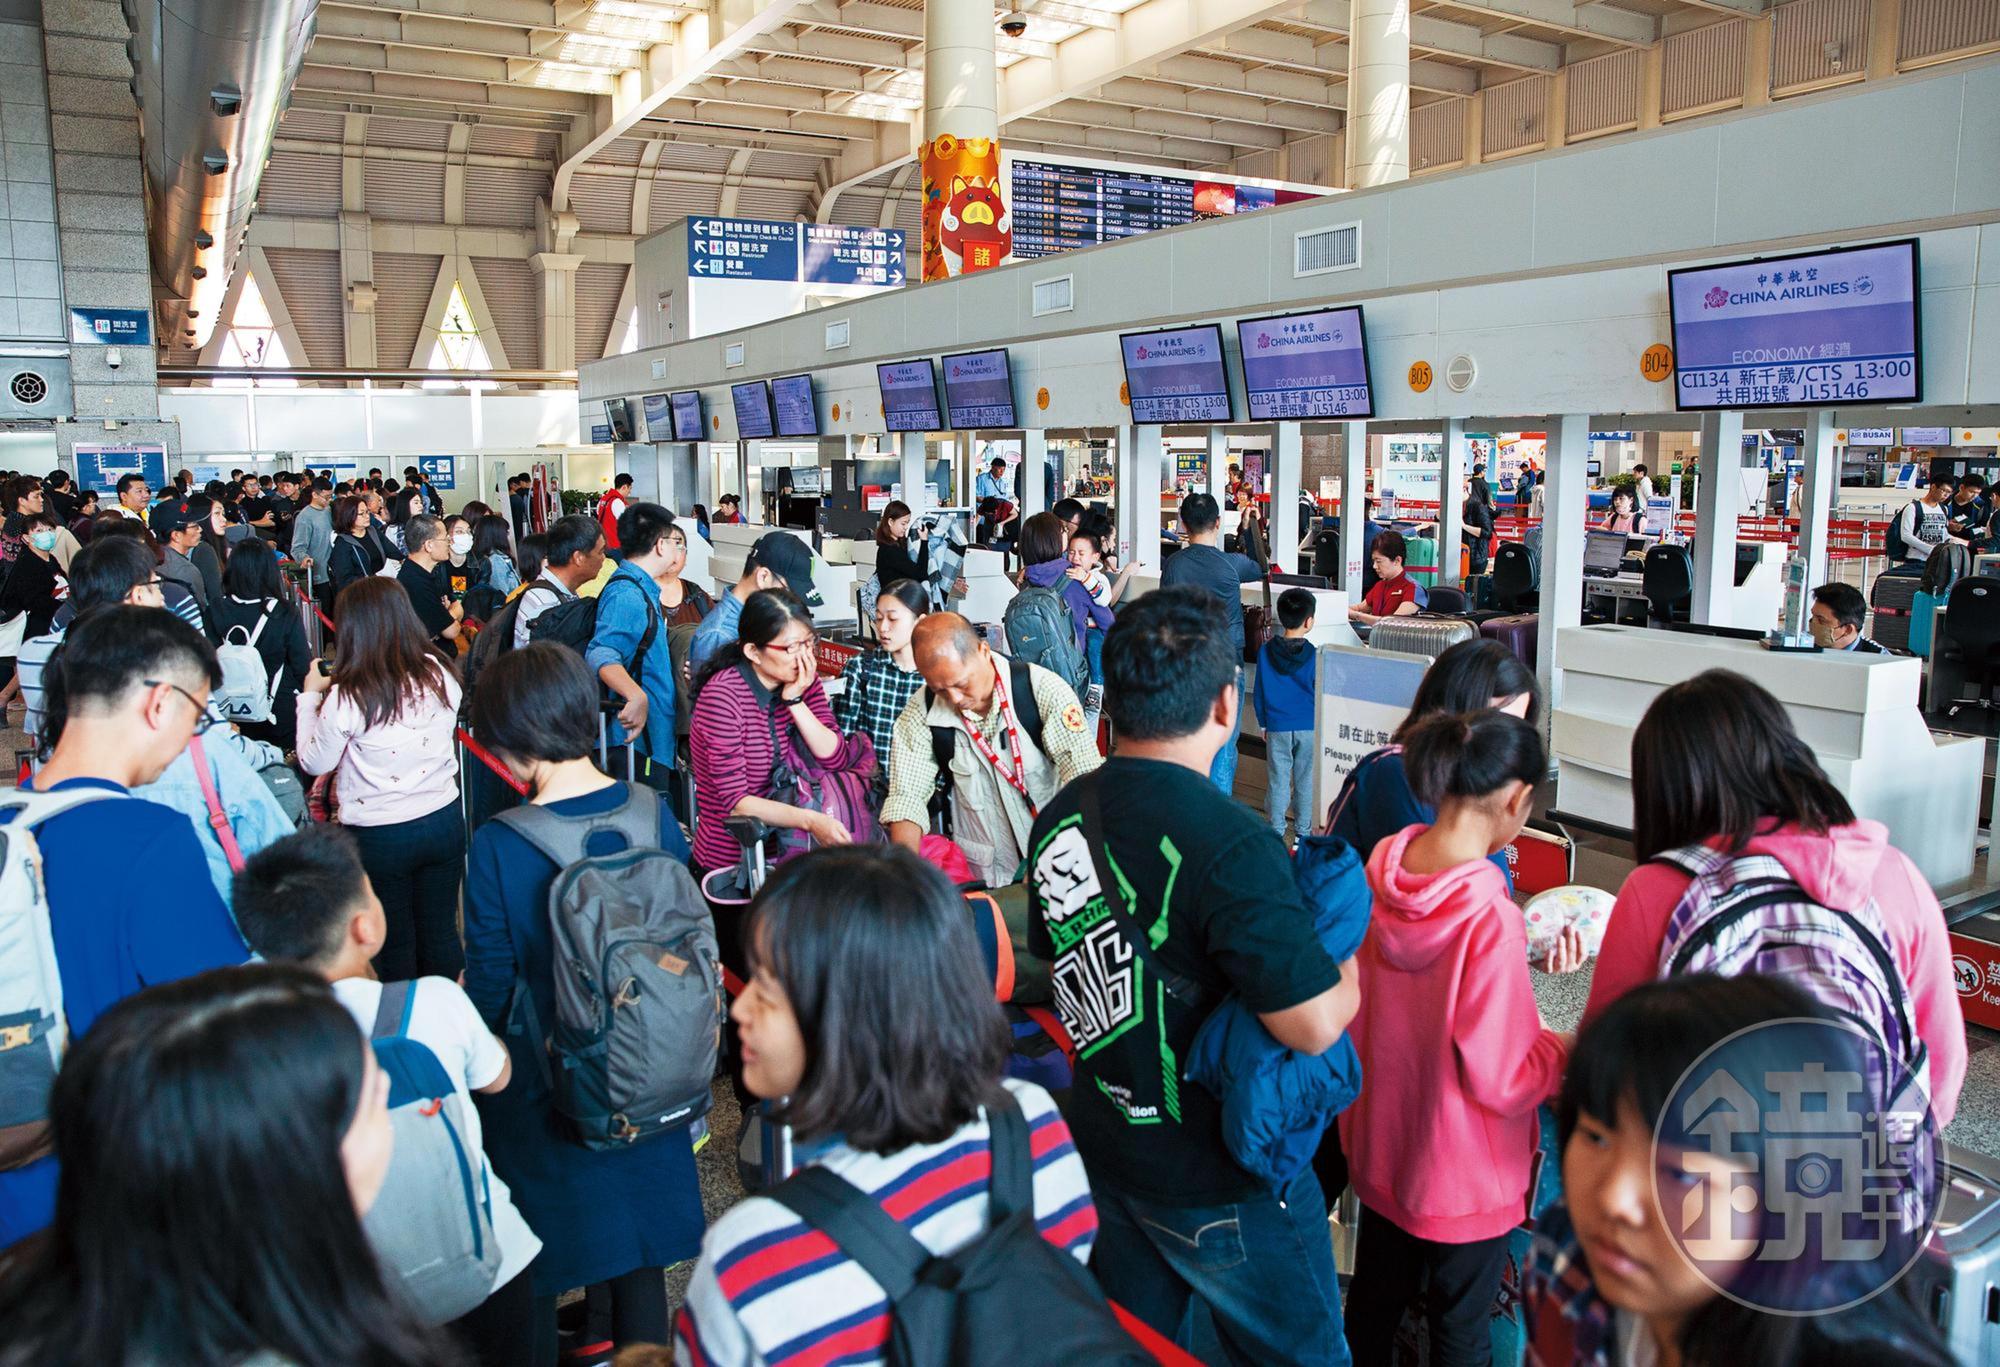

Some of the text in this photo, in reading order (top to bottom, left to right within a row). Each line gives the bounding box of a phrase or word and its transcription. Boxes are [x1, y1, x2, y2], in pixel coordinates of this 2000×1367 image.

[1757, 268, 1818, 288] 中華航空
[1730, 282, 1849, 306] CHINA AIRLINES
[1284, 322, 1314, 334] 中華航空
[1271, 333, 1331, 346] CHINA AIRLINES
[1148, 347, 1196, 358] CHINA AIRLINES
[1732, 342, 1851, 364] ECONOMY 經濟
[1276, 377, 1318, 388] ECONOMY
[1410, 368, 1431, 386] B05
[1681, 360, 1911, 389] CI134 新千歲/CTS 13:00
[1251, 394, 1276, 405] CI134
[1339, 388, 1366, 400] 13:00
[1716, 382, 1868, 405] 共用班號 JL5146
[1204, 397, 1226, 407] 13:00
[1270, 402, 1348, 417] 共用班號 JL5146
[1184, 409, 1212, 419] JL5146
[1338, 724, 1396, 746] 請在此等
[1325, 747, 1352, 762] Please
